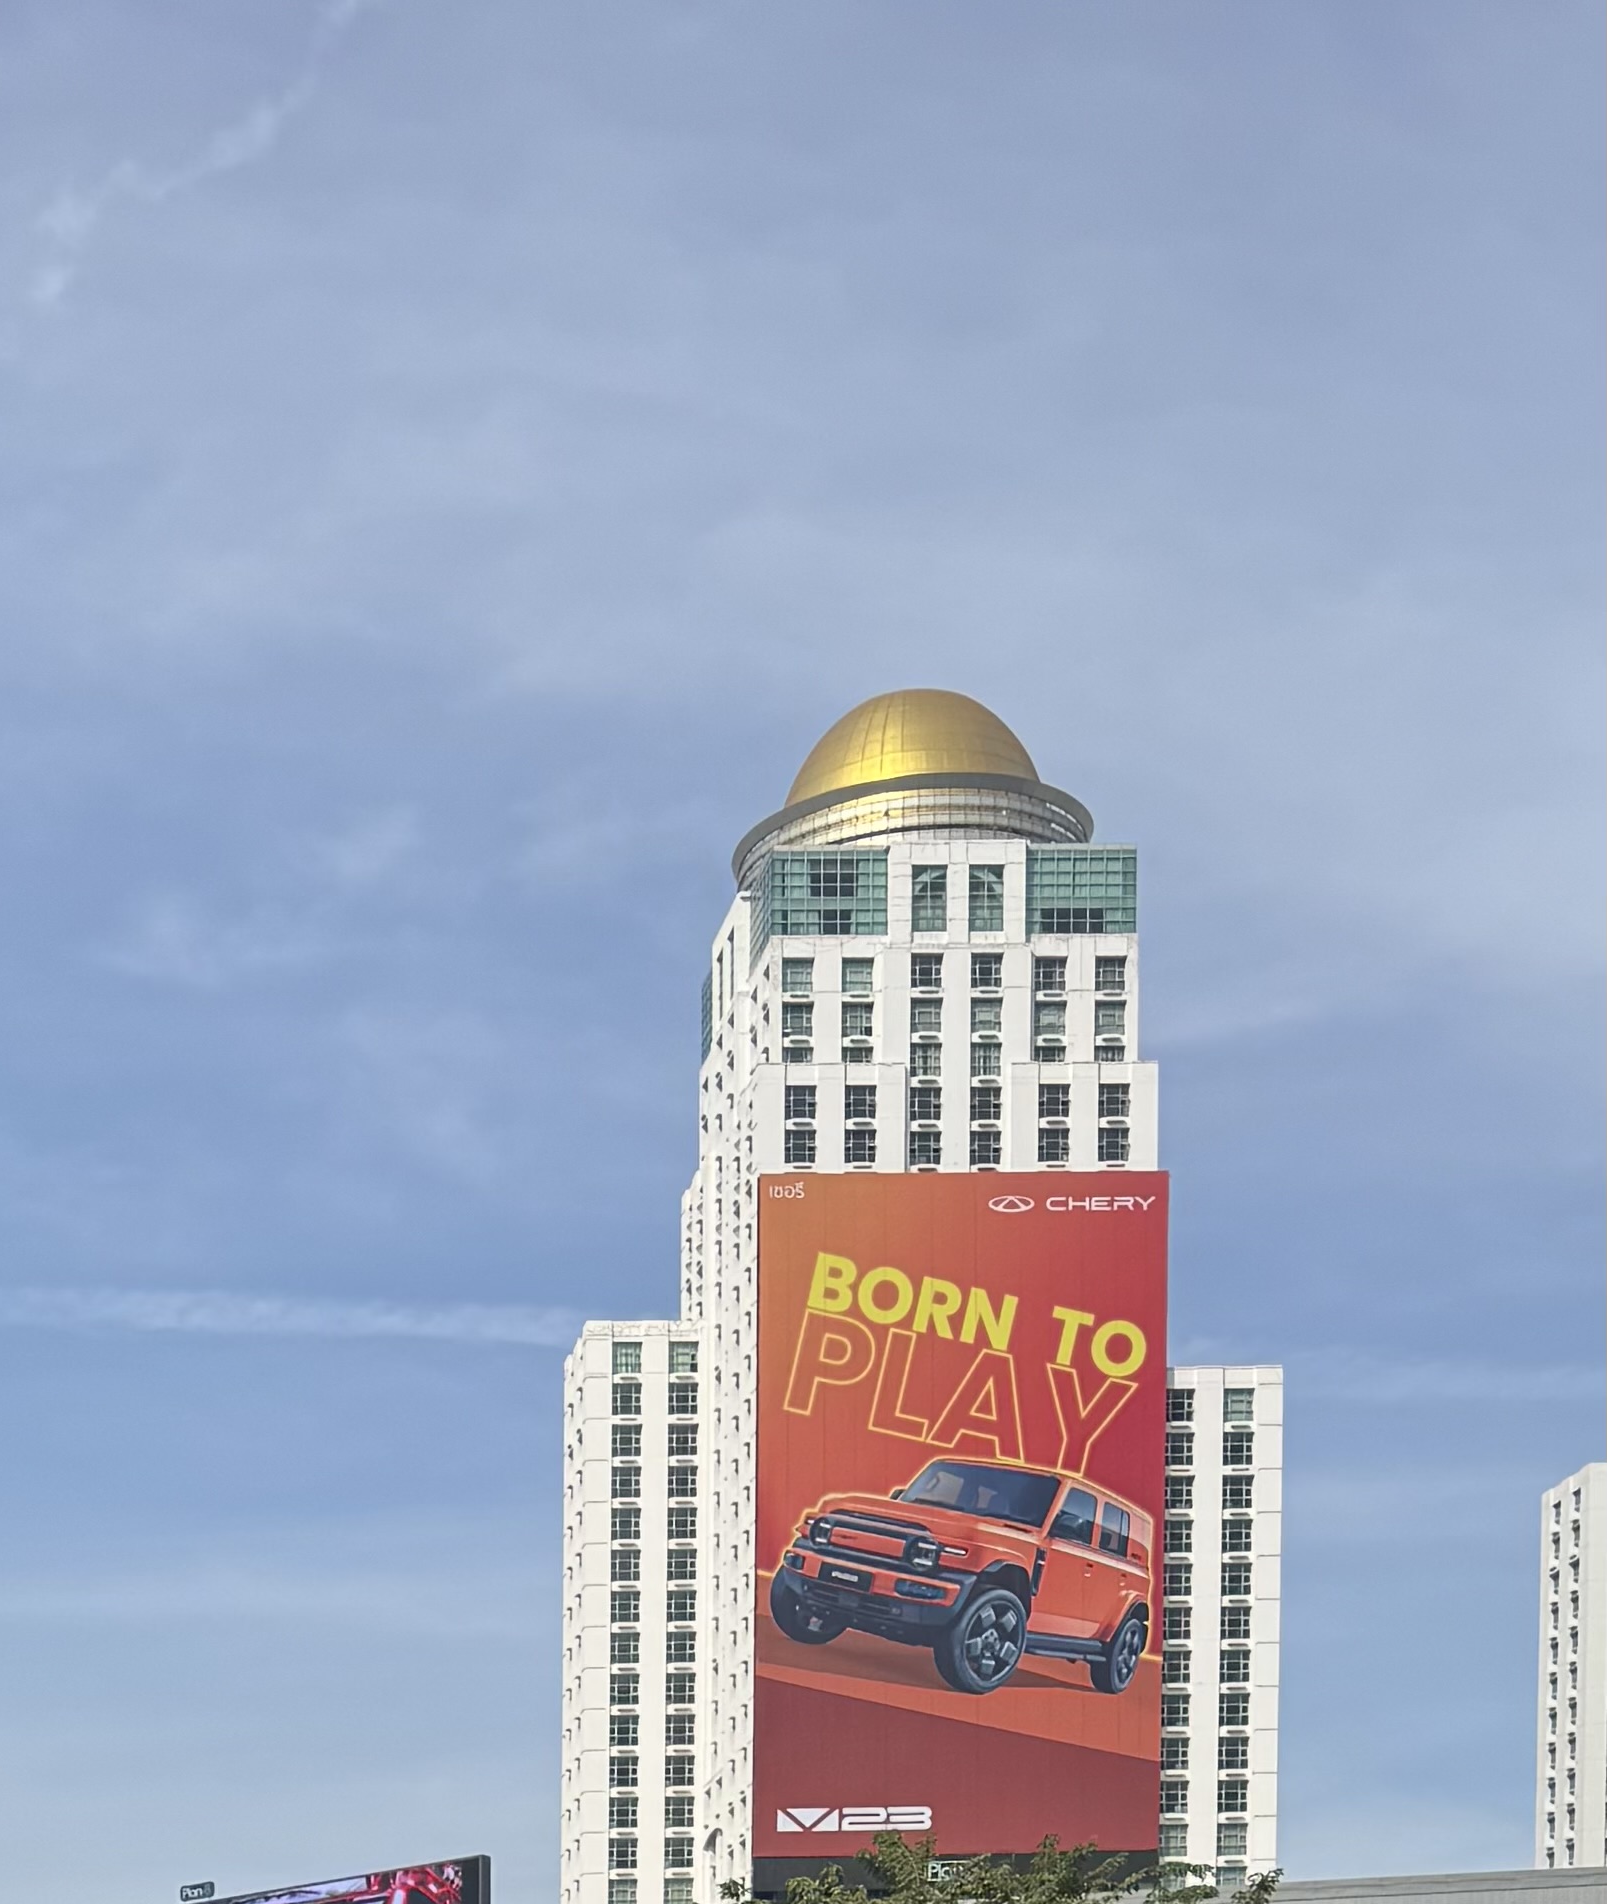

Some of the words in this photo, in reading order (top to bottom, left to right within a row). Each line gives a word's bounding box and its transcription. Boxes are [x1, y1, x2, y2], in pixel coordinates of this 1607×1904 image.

[1045, 1196, 1156, 1211] CHERY
[807, 1252, 1018, 1352] BORN
[1051, 1305, 1147, 1377] TO
[782, 1308, 1138, 1477] PLAY
